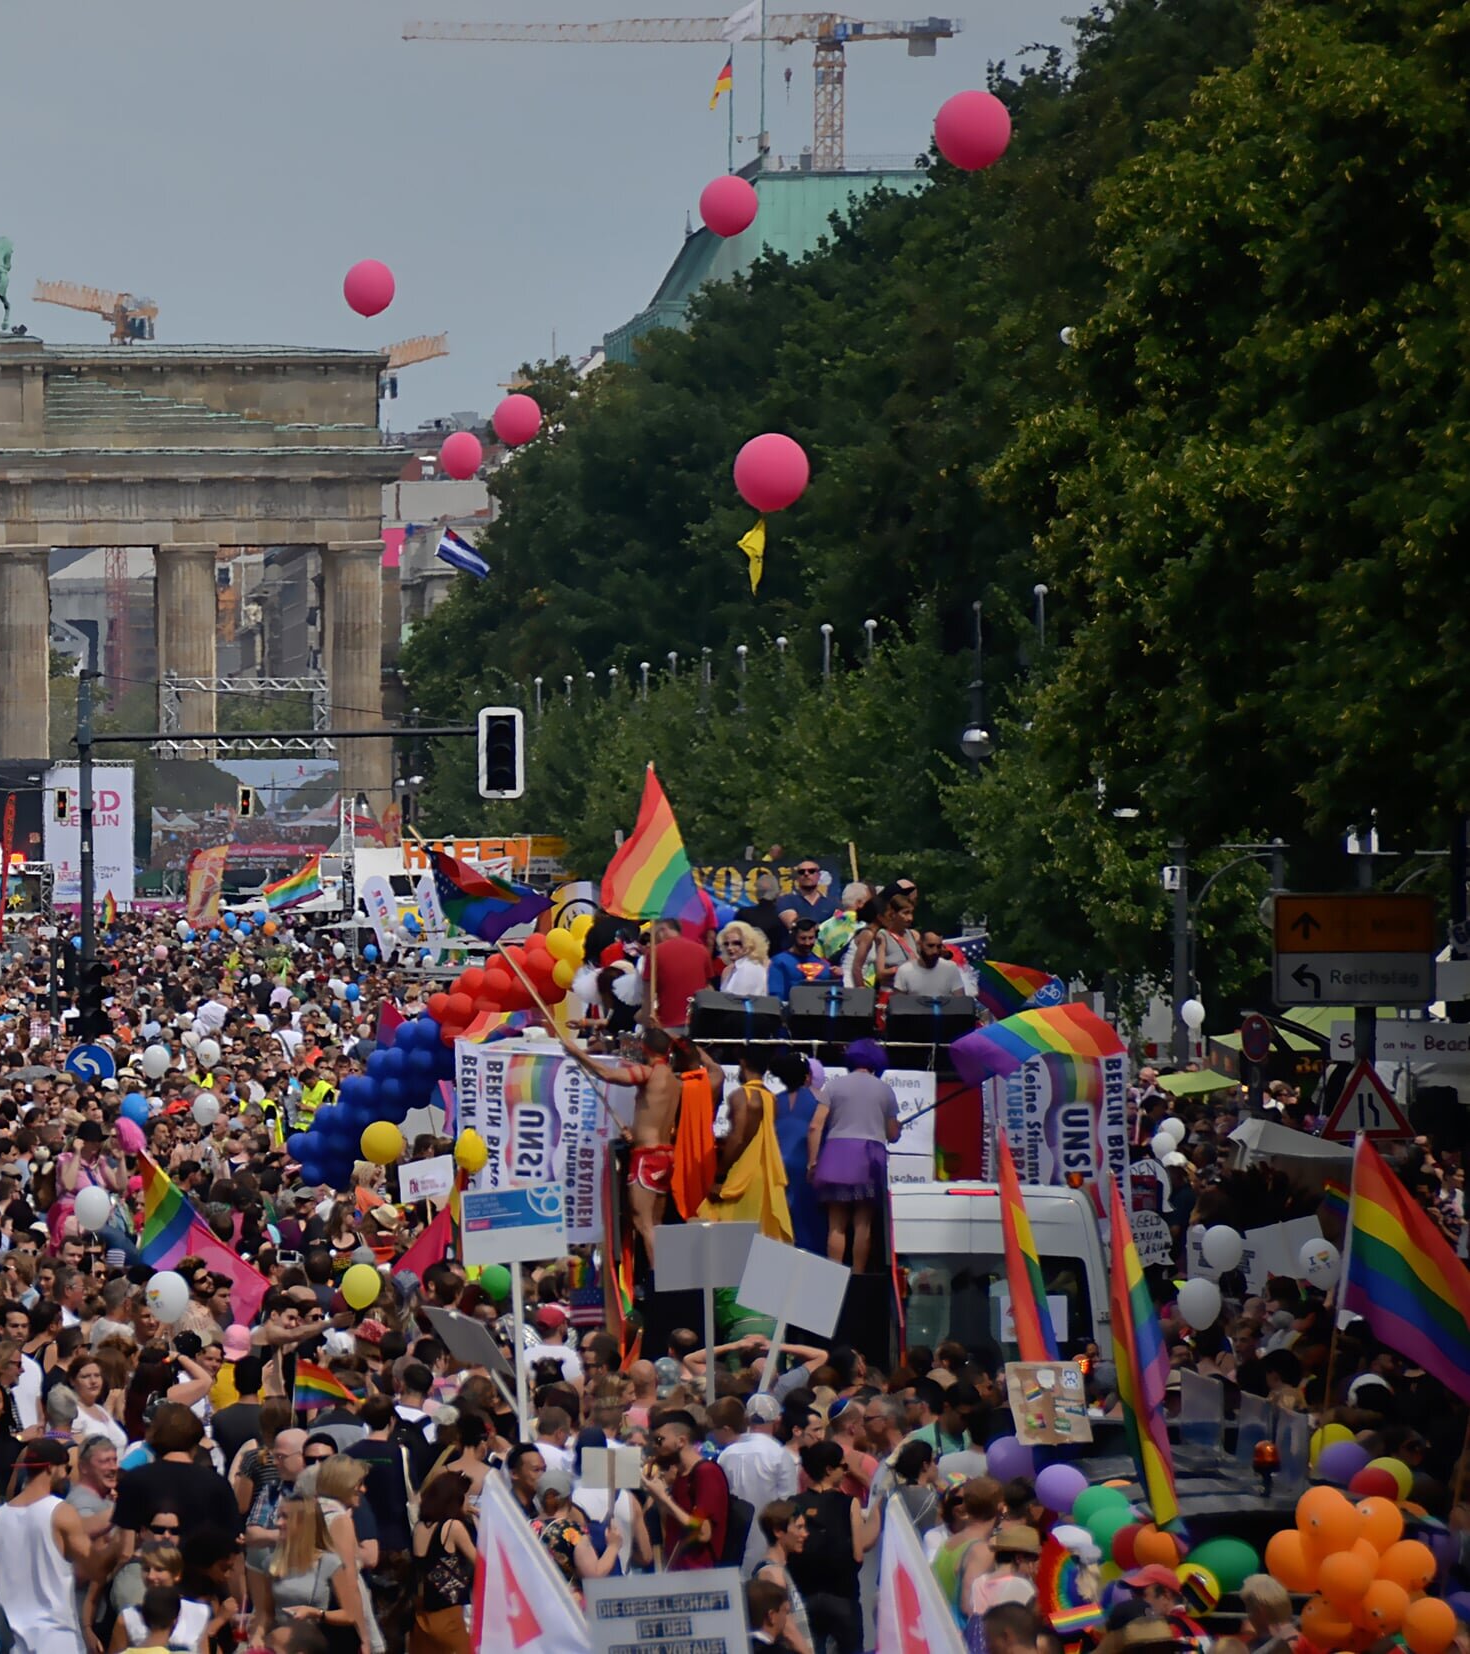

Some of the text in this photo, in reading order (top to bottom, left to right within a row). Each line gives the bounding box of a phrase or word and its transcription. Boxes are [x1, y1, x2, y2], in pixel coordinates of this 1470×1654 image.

[59, 814, 120, 827] ELIN
[1330, 968, 1420, 988] Reichstag
[1382, 1041, 1395, 1049] on
[1400, 1036, 1417, 1050] the
[1024, 1061, 1042, 1114] Keine
[1105, 1058, 1124, 1126] BERLIN
[1136, 1215, 1162, 1228] GELD
[623, 1591, 728, 1616] GESELLSCHAFT
